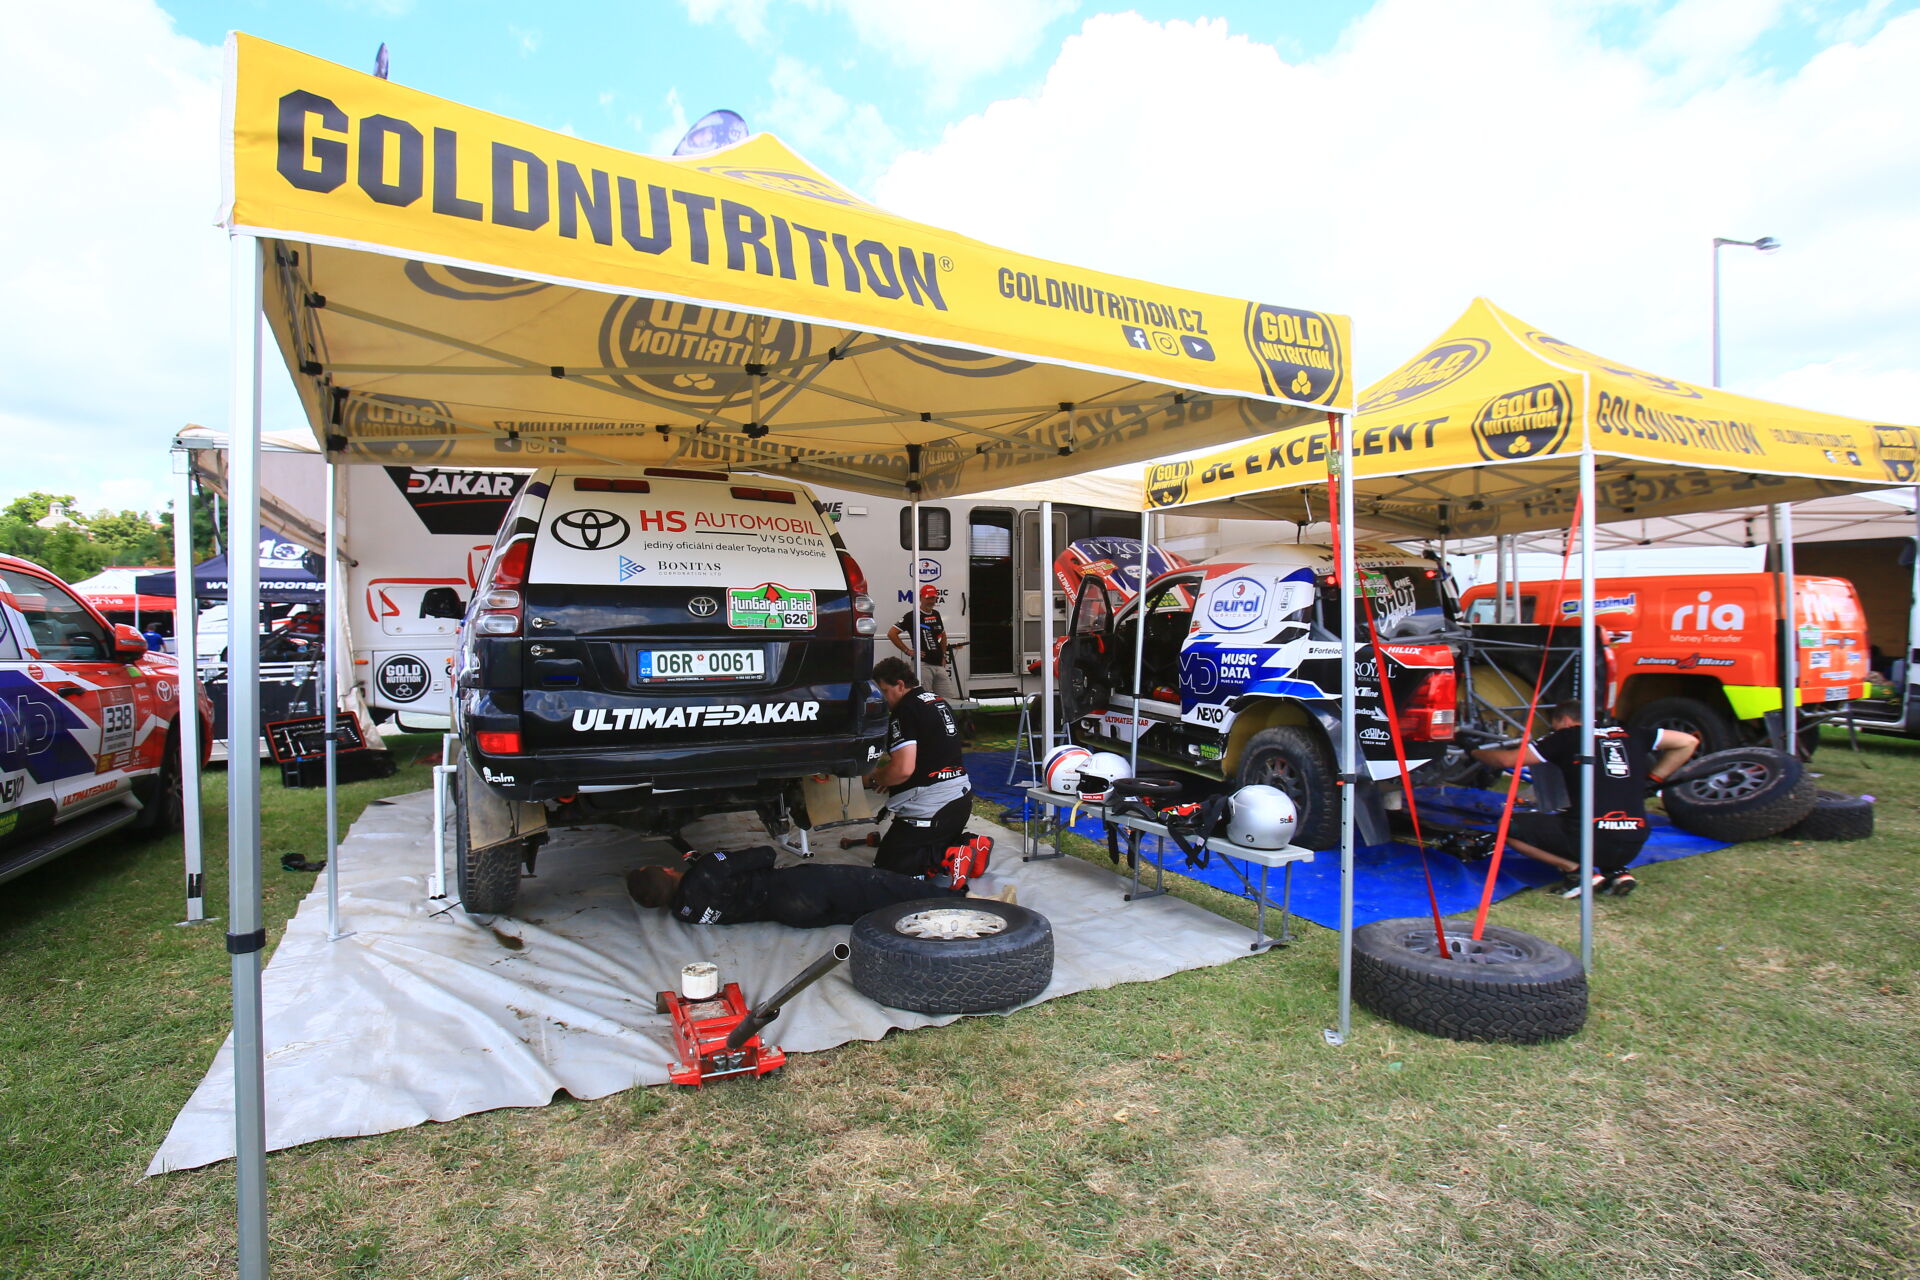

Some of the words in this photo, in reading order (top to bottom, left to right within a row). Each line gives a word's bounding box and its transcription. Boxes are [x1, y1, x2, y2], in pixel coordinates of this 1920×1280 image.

[998, 267, 1208, 335] GOLDNUTRITION.CZ
[1259, 311, 1325, 347] GOLD
[1259, 341, 1333, 370] NUTRITION
[1491, 388, 1553, 419] GOLD
[1484, 410, 1558, 436] NUTRITION
[1597, 391, 1766, 456] GOLDNUTRITION
[407, 475, 514, 496] DAKAR
[640, 510, 687, 532] HS
[694, 511, 822, 536] AUTOMOBIL
[644, 541, 674, 551] jediný
[715, 543, 745, 552] dealer
[747, 544, 776, 554] Toyota
[759, 534, 824, 548] VYSOČINA
[658, 560, 721, 571] BONITAS
[1394, 577, 1412, 588] ONE
[1213, 594, 1260, 613] eurol
[1375, 583, 1416, 634] SHOT
[1671, 591, 1745, 631] ria
[785, 614, 808, 625] 626
[1670, 634, 1701, 643] Money
[1703, 634, 1743, 643] Transfer
[1221, 653, 1258, 666] MUSIC
[1314, 647, 1343, 655] Forteloc
[1387, 646, 1423, 655] HILUX
[385, 664, 422, 676] GOLD
[657, 653, 693, 674] 06R
[708, 652, 755, 673] 0061
[386, 675, 423, 684] NUTRITION
[1220, 666, 1251, 679] DATA
[106, 705, 132, 733] 338
[1197, 706, 1224, 724] NEXO
[1598, 820, 1638, 830] HILUX
